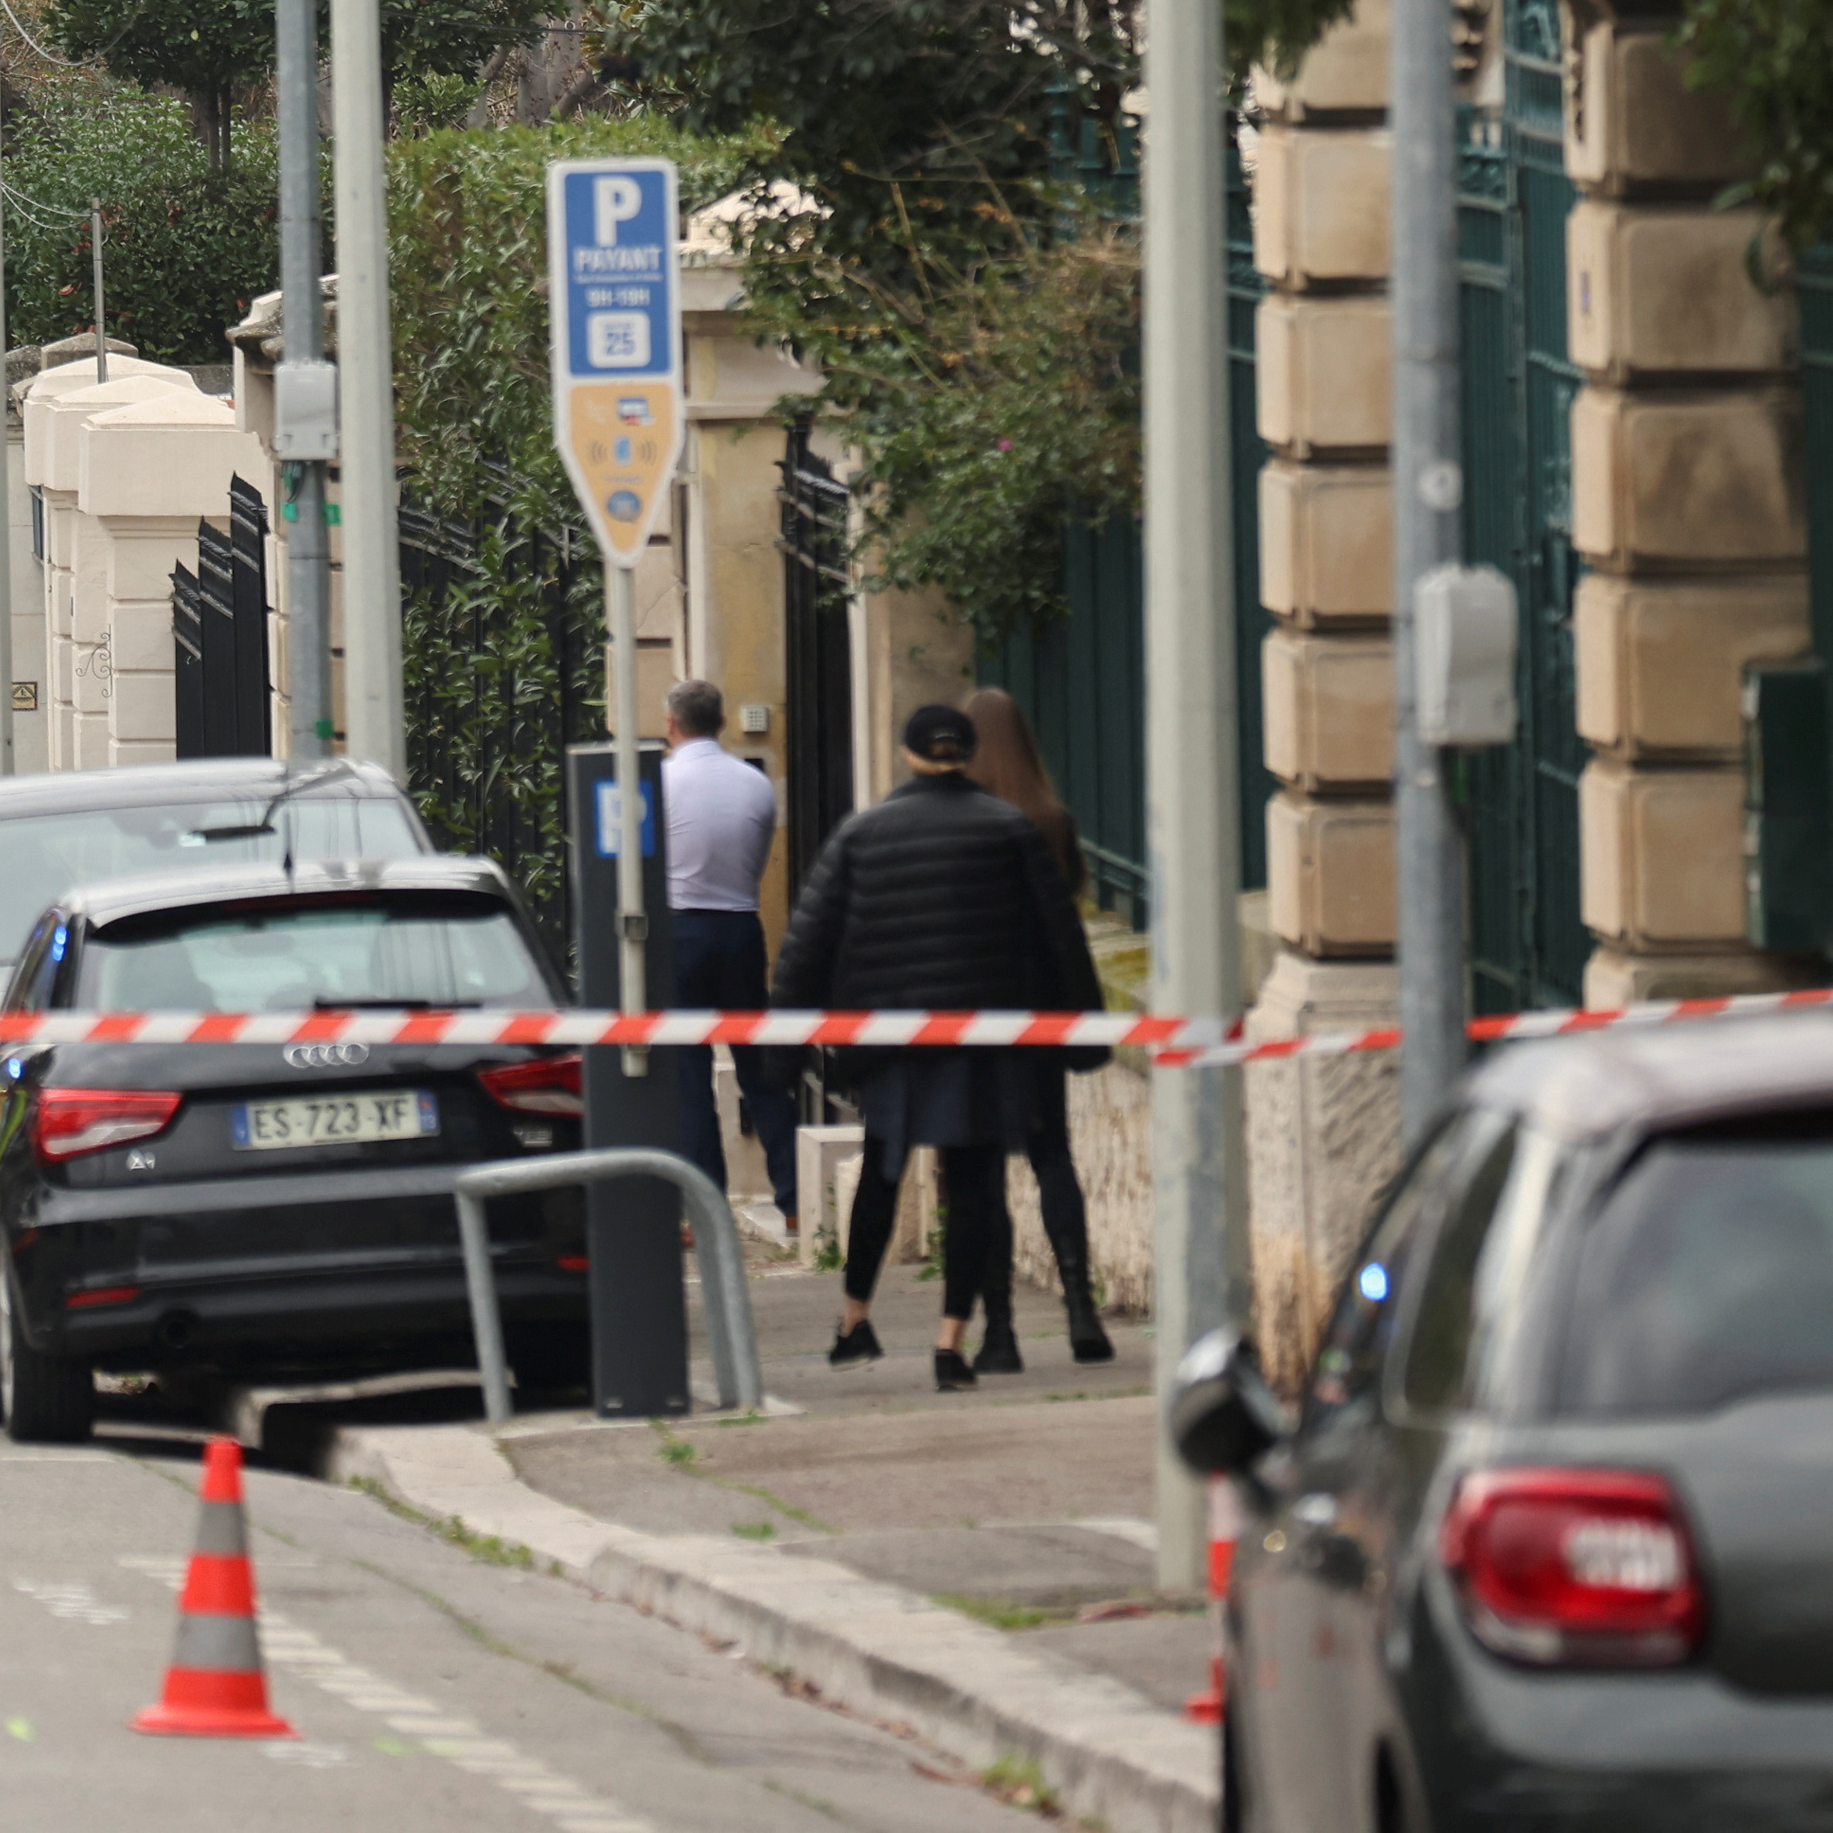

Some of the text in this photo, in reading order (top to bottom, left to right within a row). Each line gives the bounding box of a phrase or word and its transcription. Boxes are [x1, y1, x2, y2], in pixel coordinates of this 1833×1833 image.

[594, 175, 642, 246] P
[574, 246, 663, 272] PAYANT
[605, 332, 636, 356] 25
[254, 1099, 409, 1140] ES-723-XF
